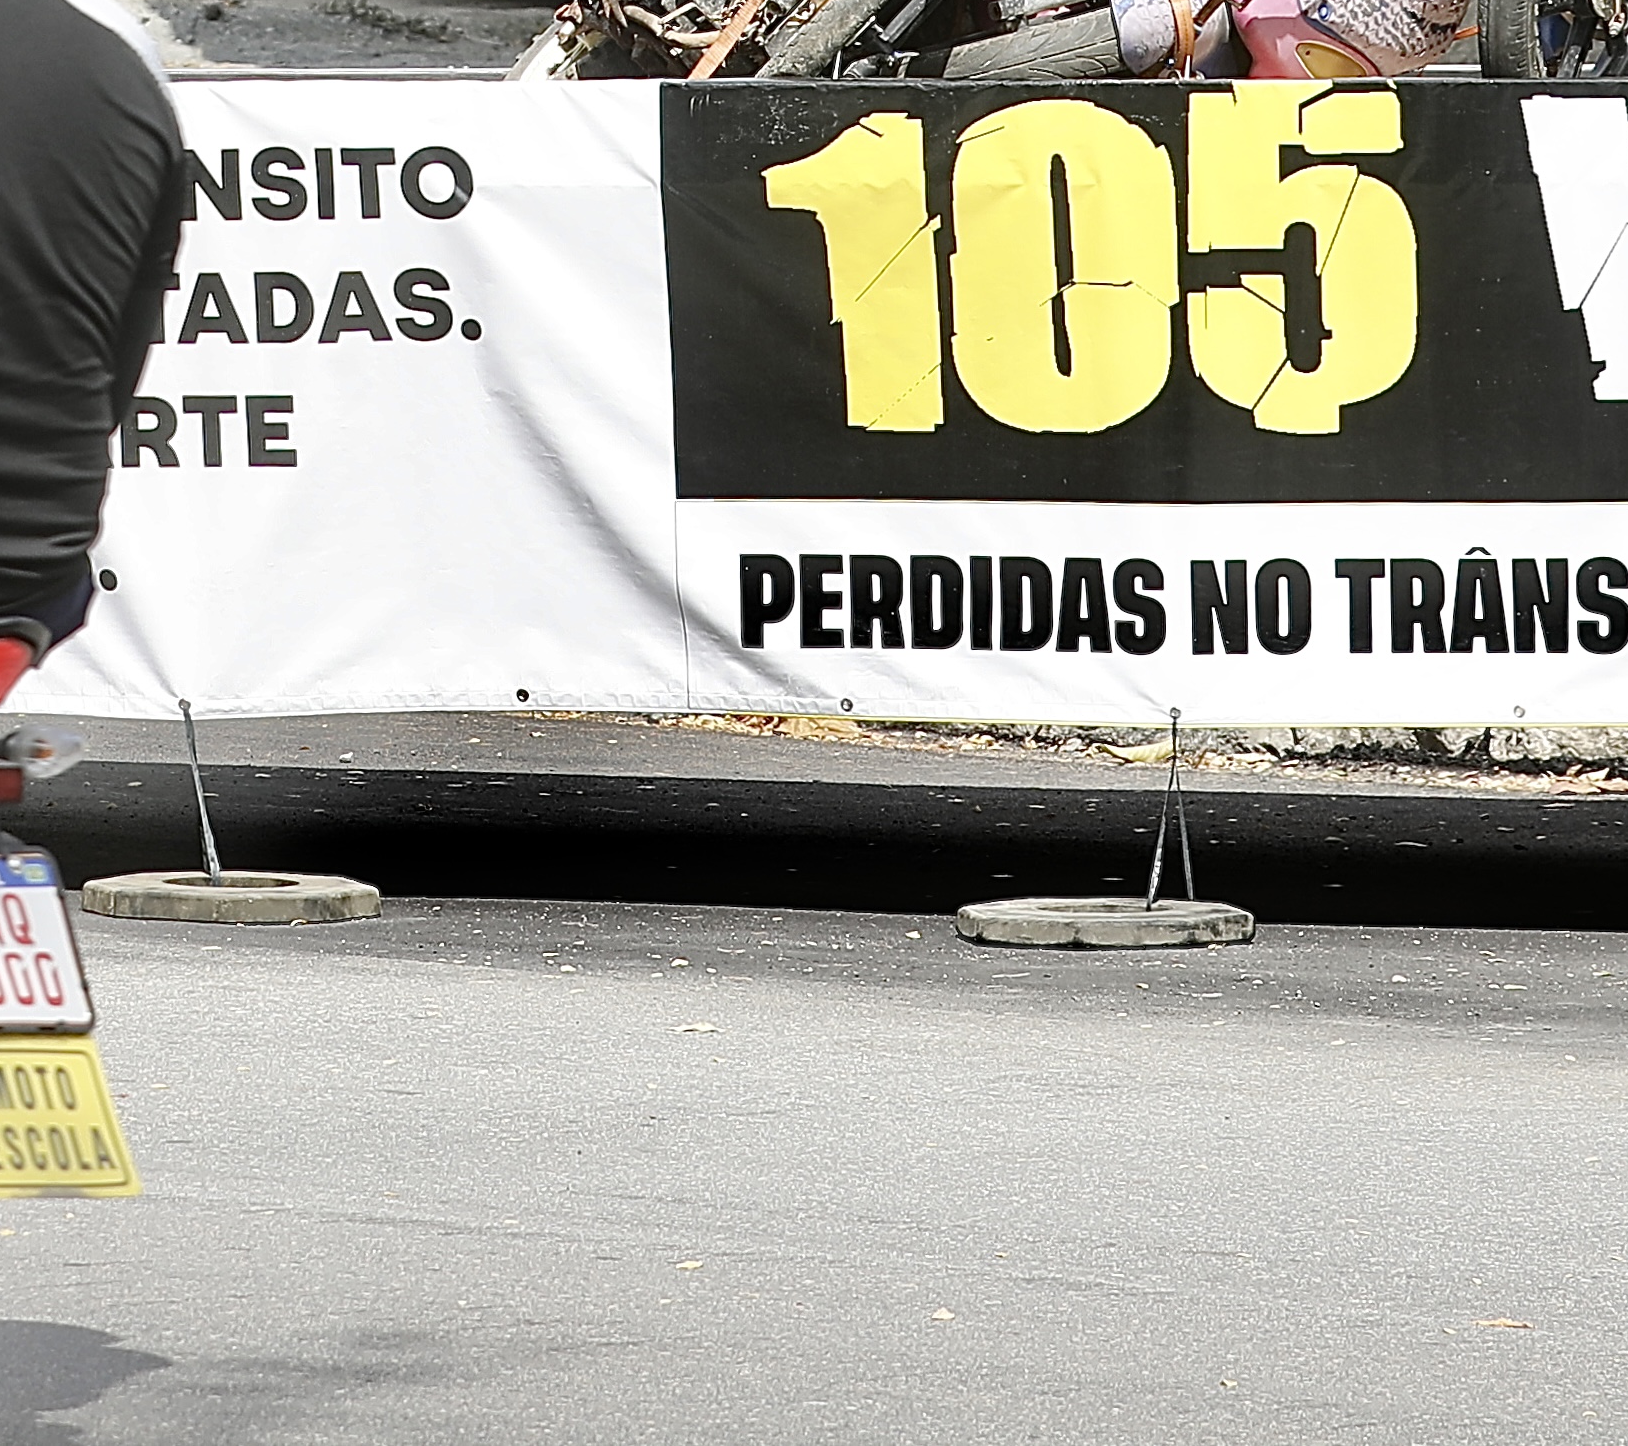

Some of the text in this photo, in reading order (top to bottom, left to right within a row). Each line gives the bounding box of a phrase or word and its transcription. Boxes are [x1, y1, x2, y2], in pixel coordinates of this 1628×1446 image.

[180, 146, 474, 221] NSITO
[760, 79, 1419, 436] 105
[109, 393, 299, 470] RTE
[739, 552, 1168, 655] PERDIDAS
[1190, 557, 1312, 655] NO
